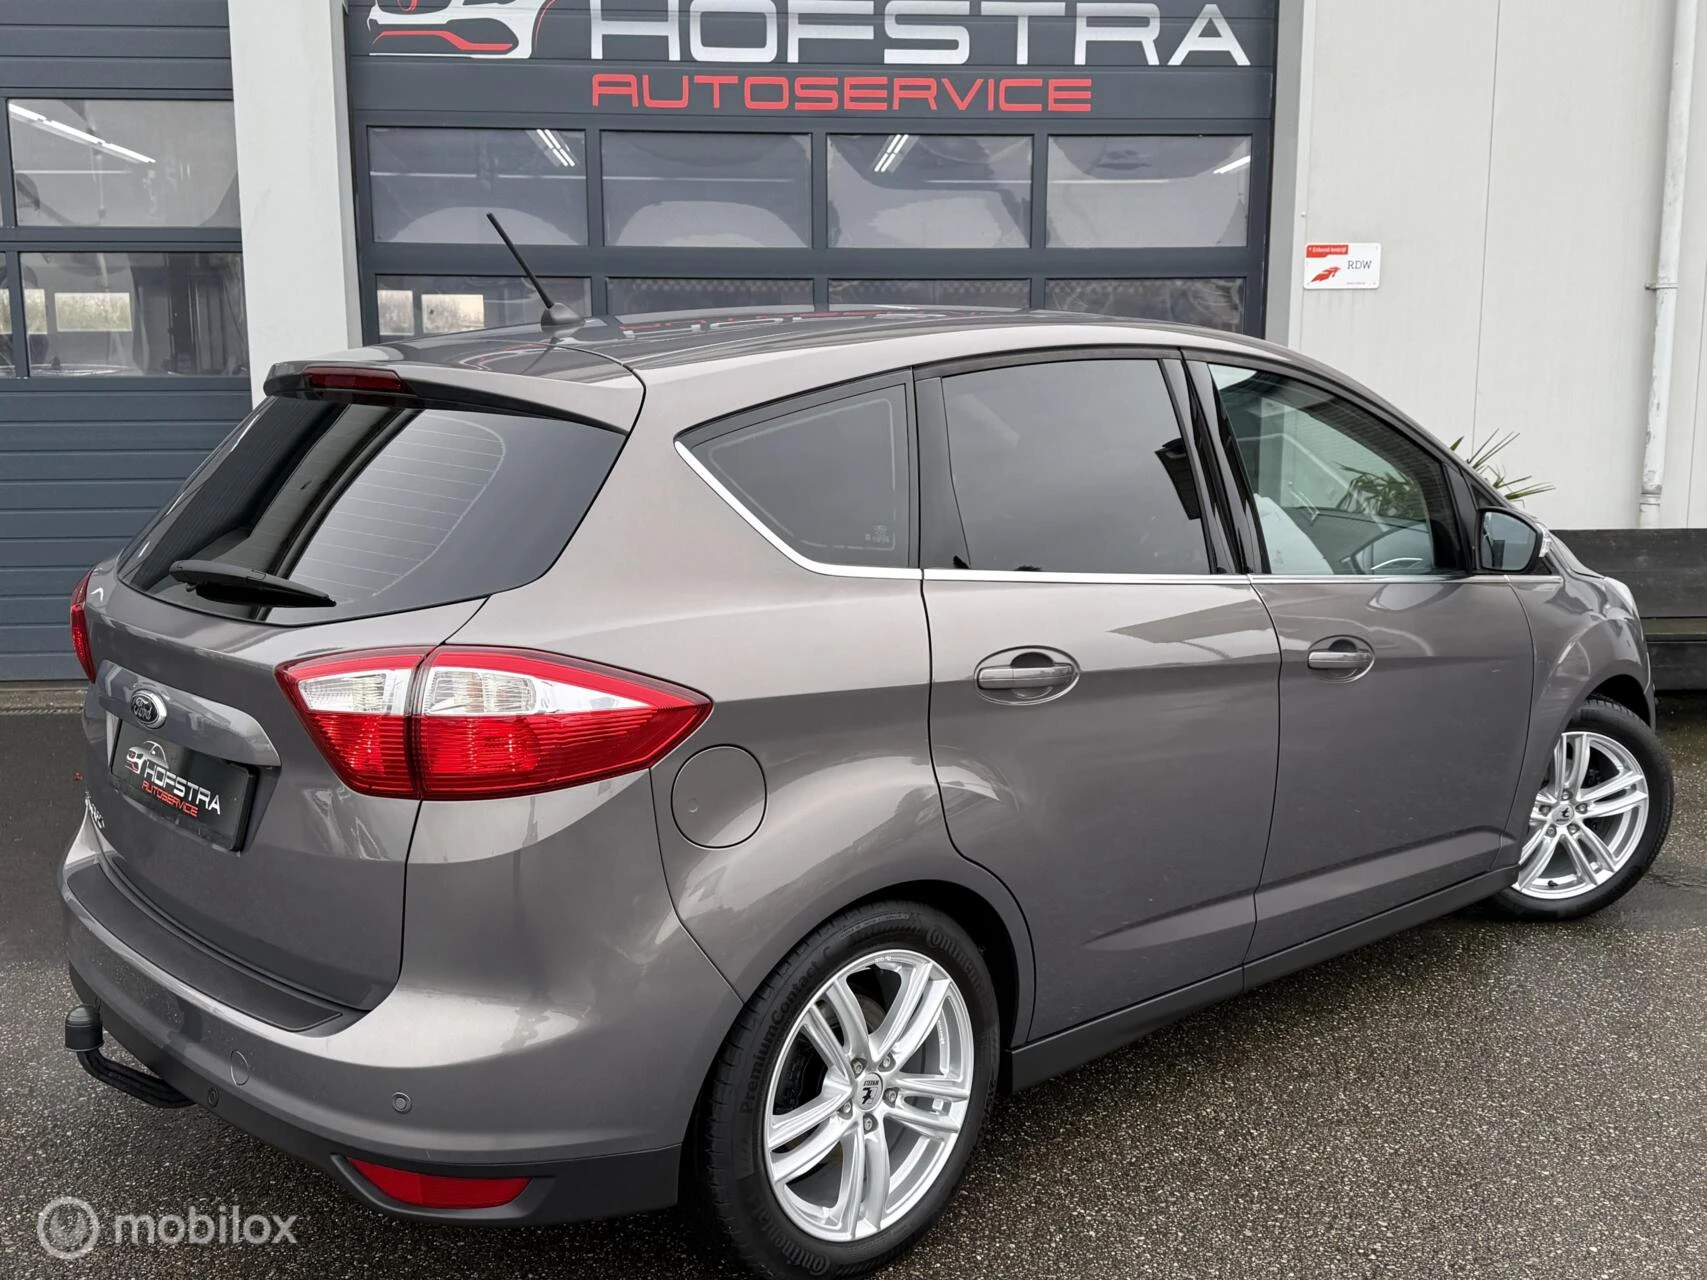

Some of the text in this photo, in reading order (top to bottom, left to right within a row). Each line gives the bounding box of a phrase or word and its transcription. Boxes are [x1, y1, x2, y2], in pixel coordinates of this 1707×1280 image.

[590, 0, 1251, 66] HOFSTRA
[592, 74, 1092, 112] AUTOSERVICE
[1347, 260, 1372, 270] RDW
[142, 780, 199, 817] AUTOSERVICE
[144, 764, 221, 815] HOFSTRA
[741, 961, 823, 1114] PremiumContact
